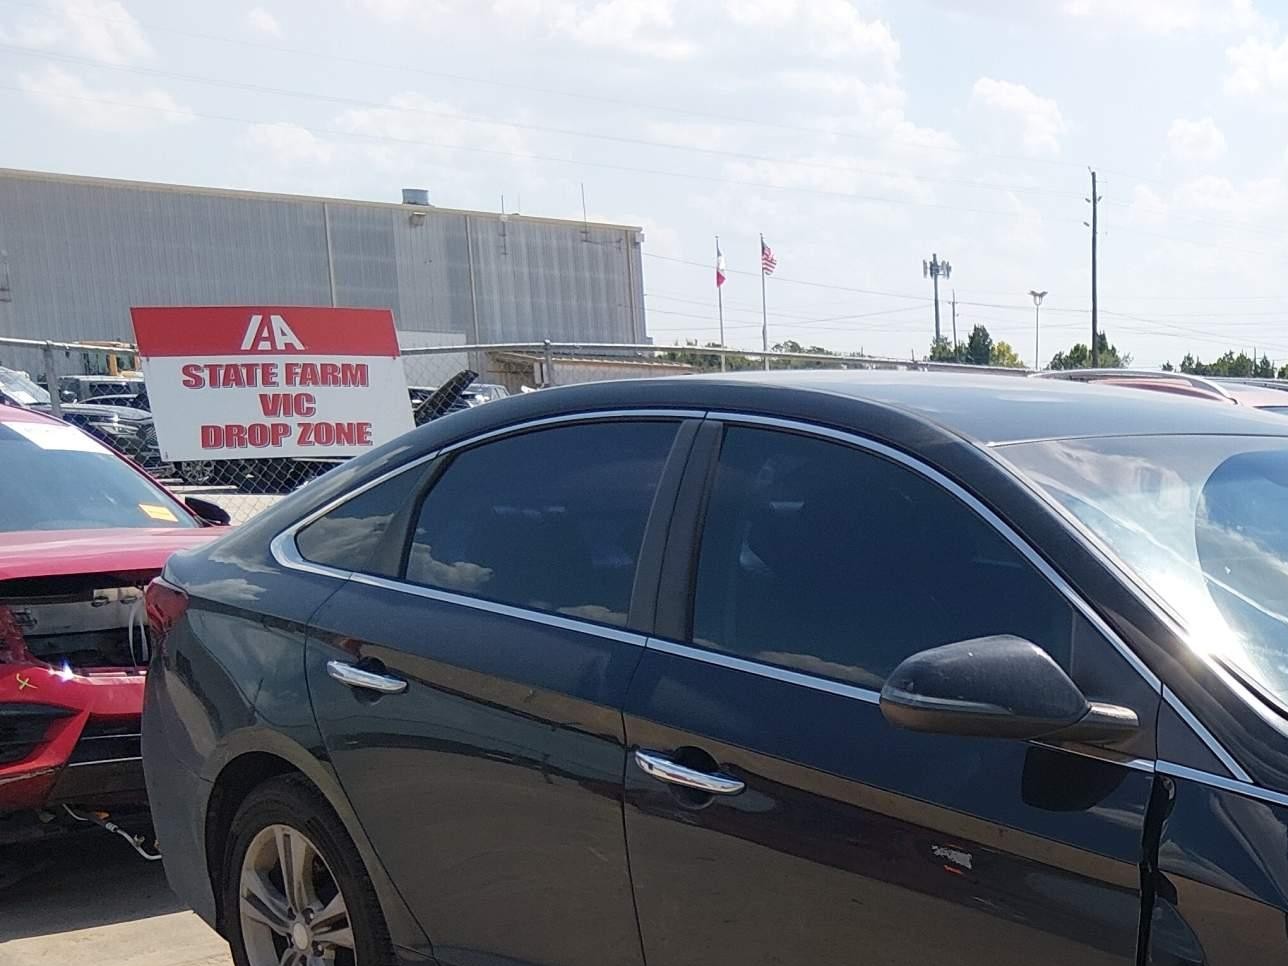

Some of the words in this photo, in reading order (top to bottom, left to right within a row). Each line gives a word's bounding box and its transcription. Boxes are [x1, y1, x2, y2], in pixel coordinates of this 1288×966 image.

[181, 363, 279, 388] STATE
[284, 363, 369, 387] FARM
[259, 393, 317, 417] VIC
[200, 423, 291, 449] DROP
[296, 422, 373, 446] ZONE
